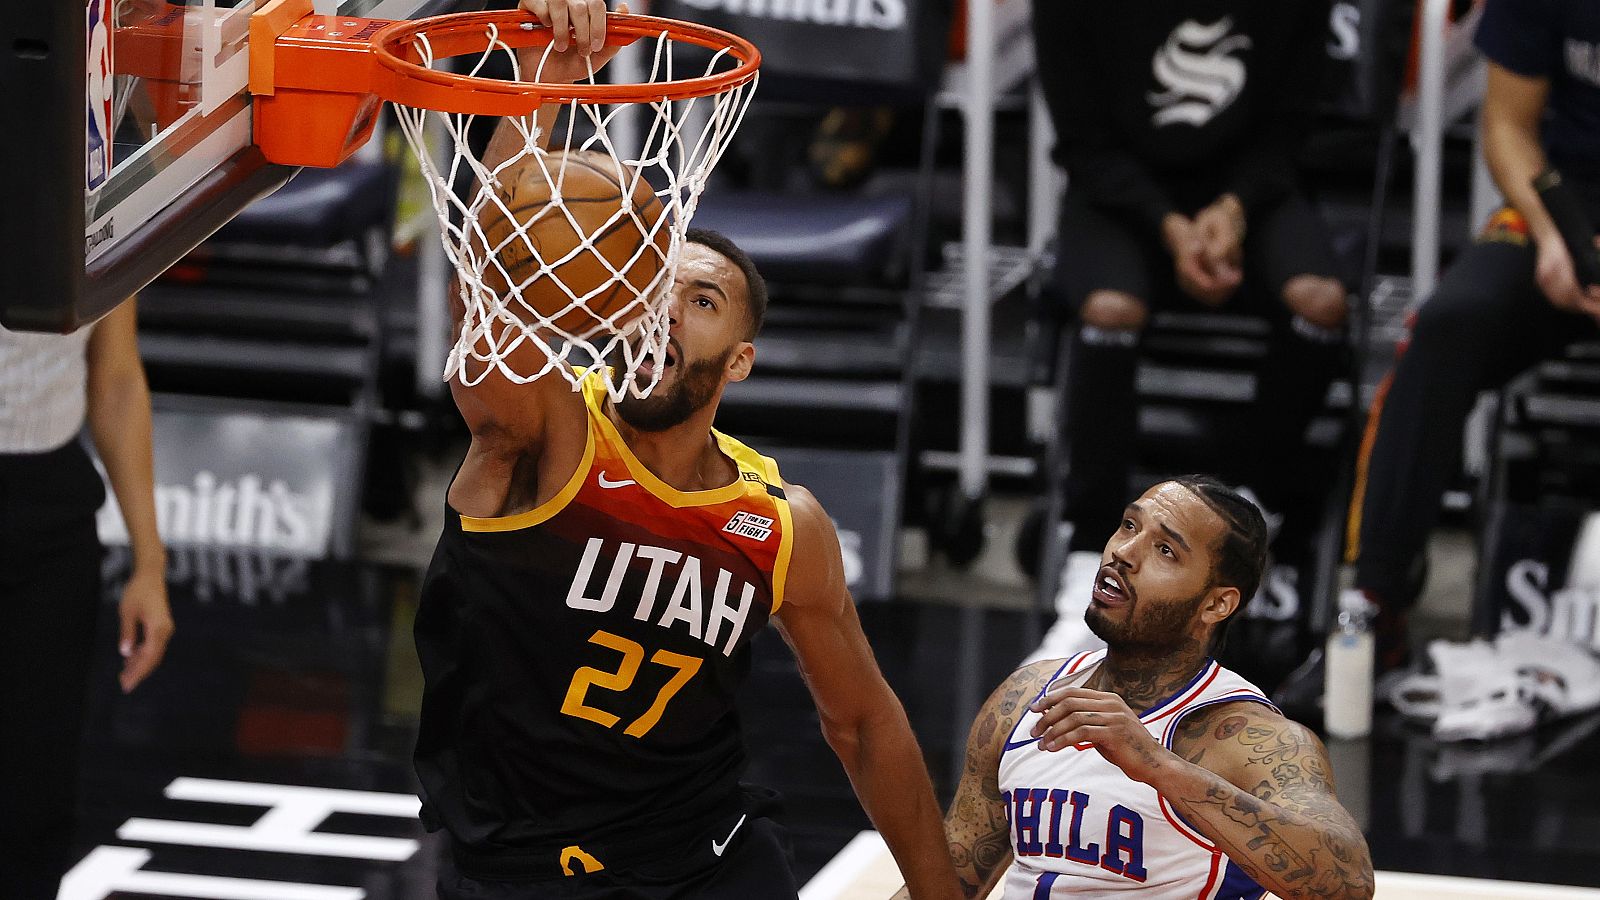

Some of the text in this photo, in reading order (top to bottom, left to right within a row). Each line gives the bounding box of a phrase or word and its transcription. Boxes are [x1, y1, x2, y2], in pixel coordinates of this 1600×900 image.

[95, 470, 309, 549] mith's
[726, 512, 745, 531] 5
[738, 524, 768, 539] FIGHT
[747, 515, 770, 526] FOR THE
[566, 537, 756, 657] UTAH
[560, 630, 704, 738] 27
